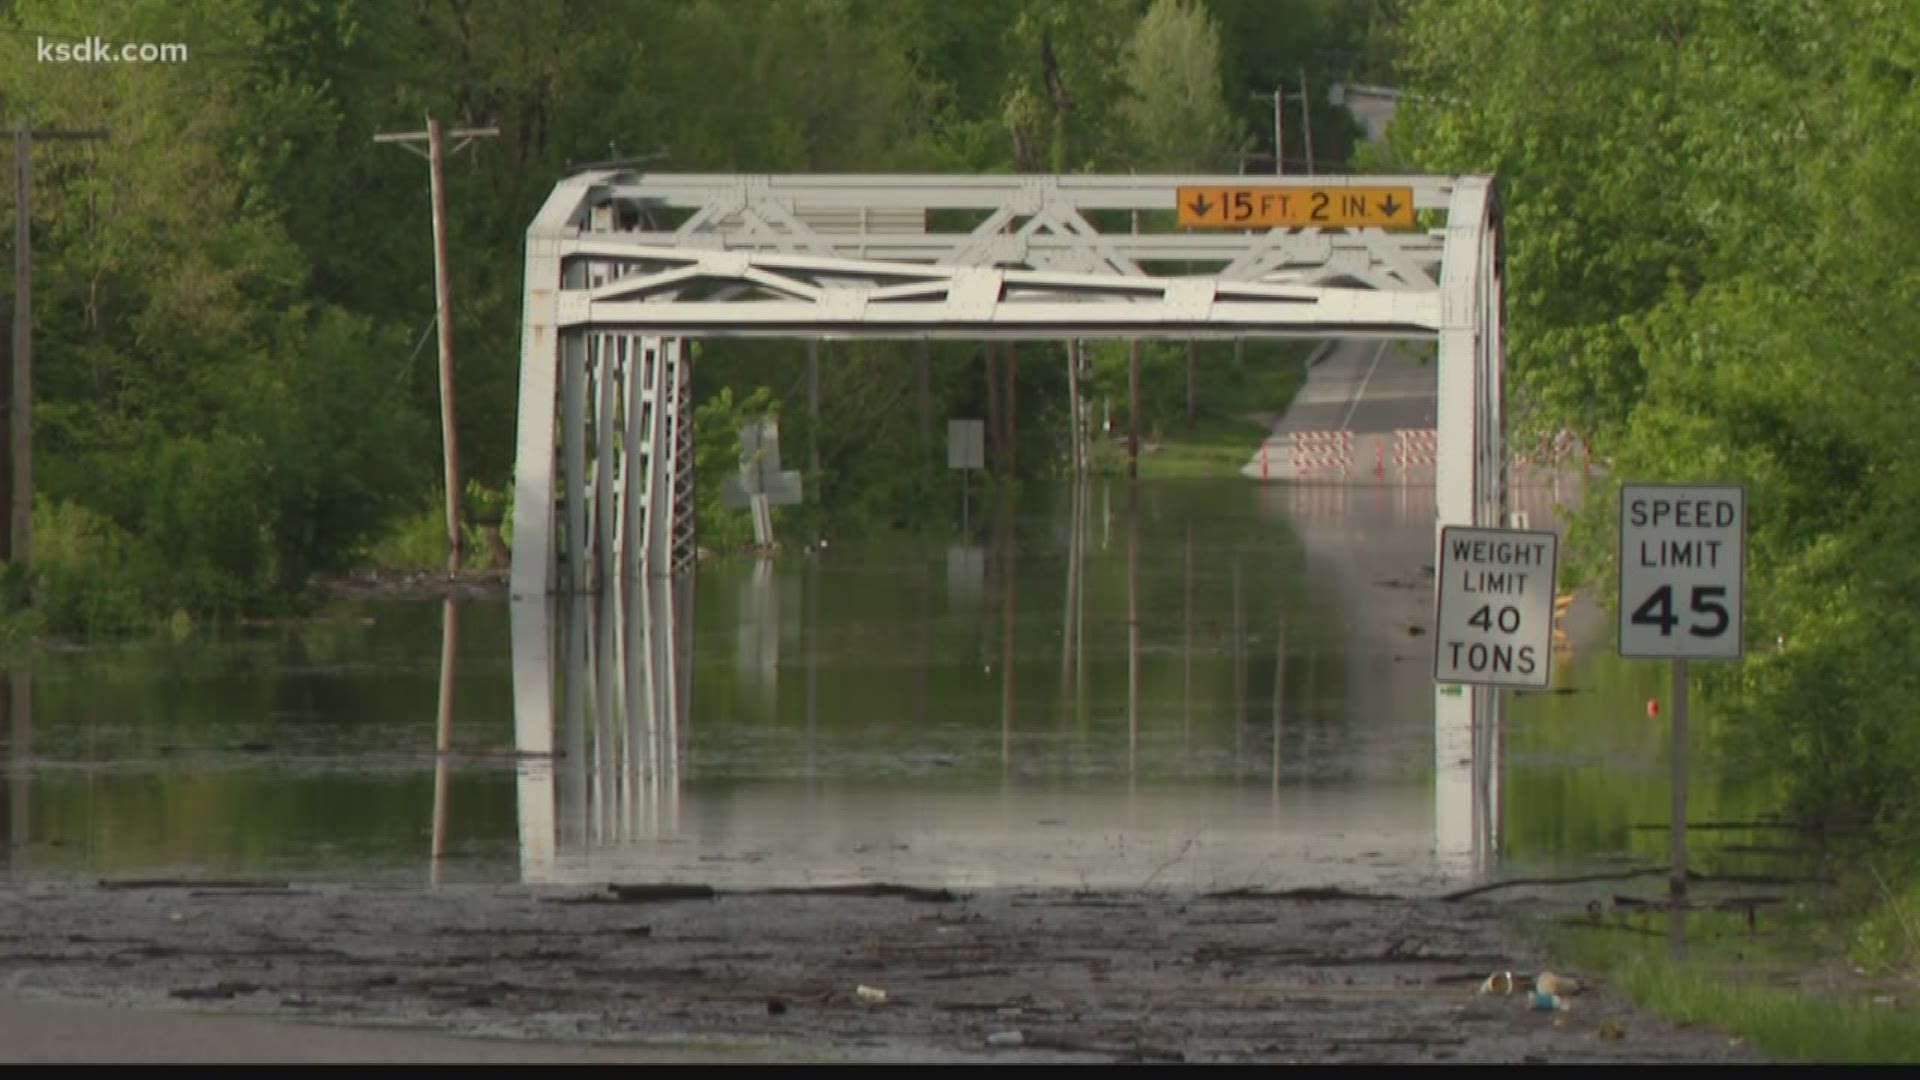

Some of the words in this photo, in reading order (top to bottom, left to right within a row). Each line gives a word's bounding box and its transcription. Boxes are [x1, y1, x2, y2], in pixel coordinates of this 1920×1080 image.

[1222, 192, 1253, 221] 15
[1261, 195, 1296, 217] FT.
[1310, 192, 1330, 221] 2
[1342, 195, 1371, 217] IN.
[1630, 500, 1735, 527] SPEED
[1453, 540, 1546, 565] WEIGHT
[1640, 540, 1722, 568] LIMIT
[1464, 571, 1528, 595] LIMIT
[1468, 605, 1521, 634] 40
[1631, 584, 1730, 638] 45
[1448, 641, 1536, 674] TONS
